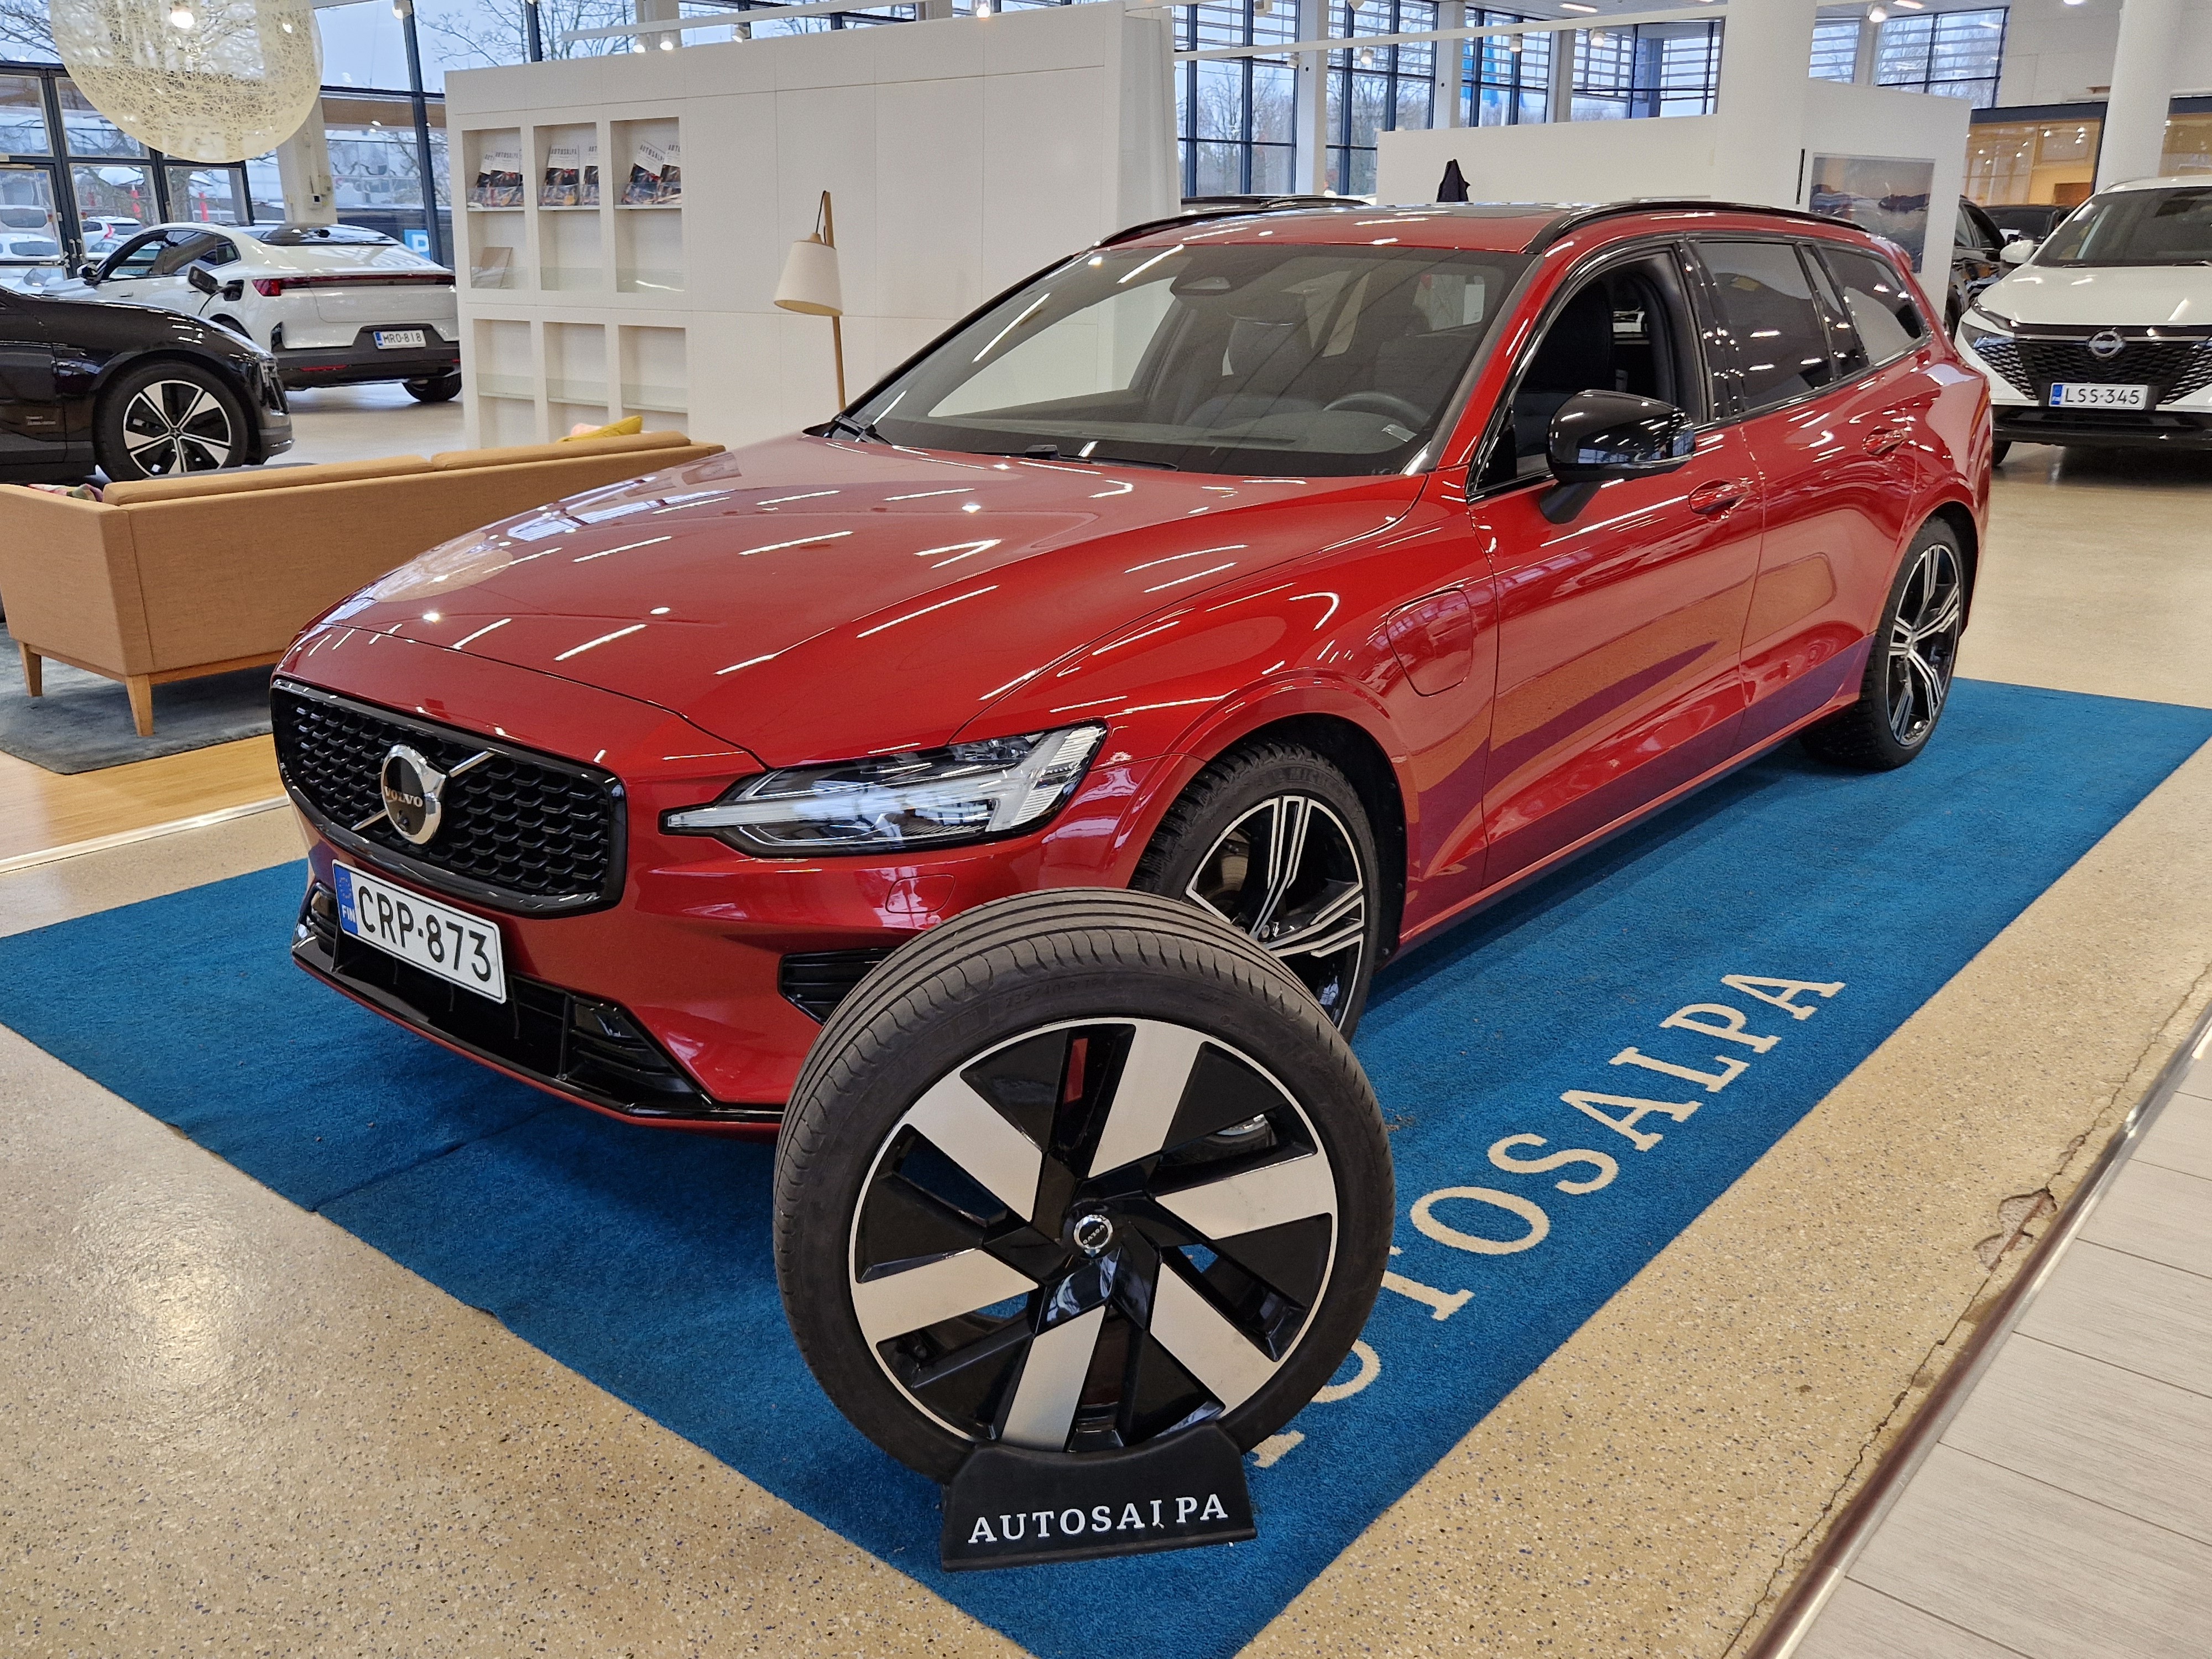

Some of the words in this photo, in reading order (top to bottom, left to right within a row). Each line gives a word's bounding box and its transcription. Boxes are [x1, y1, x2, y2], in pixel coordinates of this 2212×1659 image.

[412, 234, 430, 253] P
[2065, 388, 2140, 404] LSS-345
[384, 786, 423, 807] VOLVO
[341, 904, 357, 924] FIN
[358, 885, 492, 982] CRP-873
[1251, 974, 1846, 1469] TOSALPA
